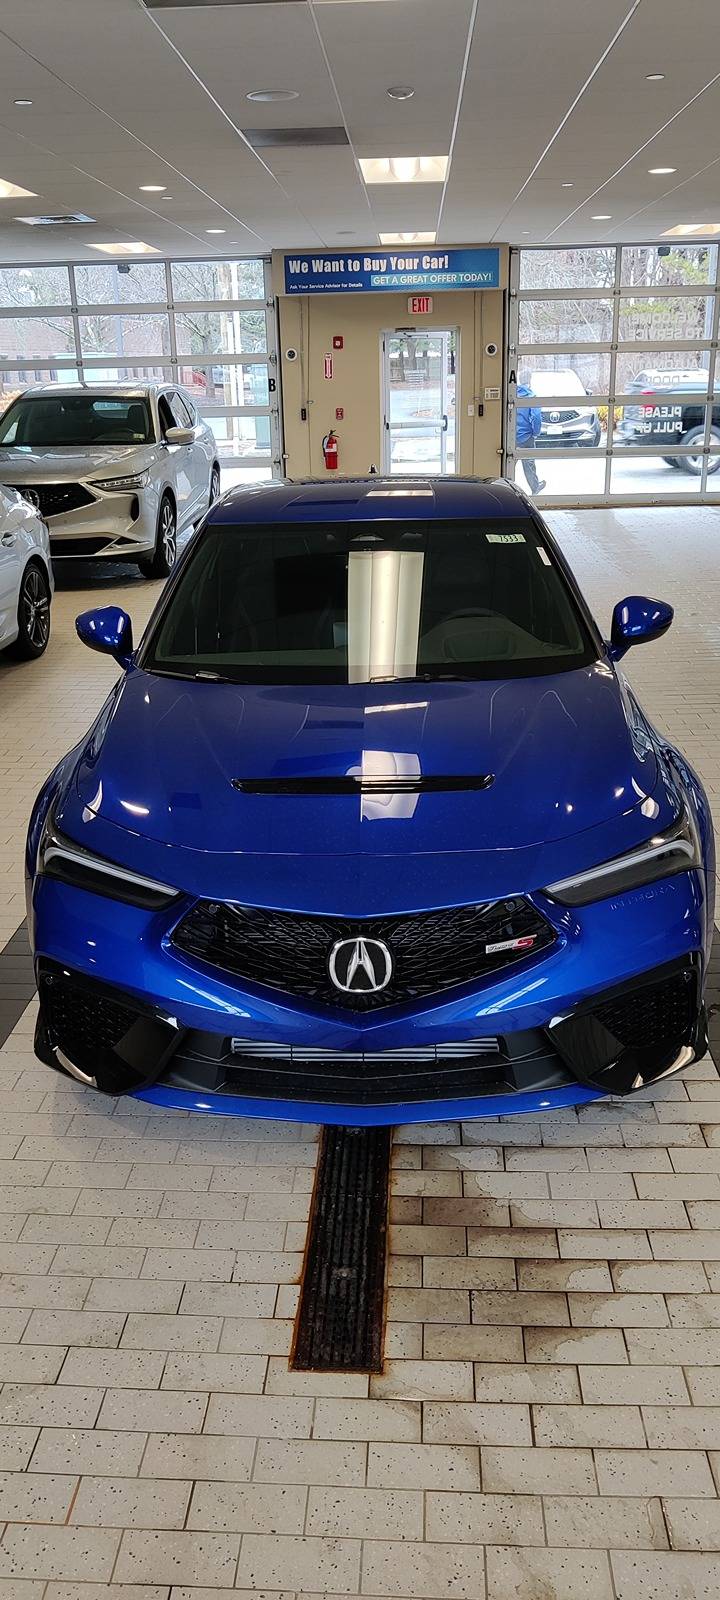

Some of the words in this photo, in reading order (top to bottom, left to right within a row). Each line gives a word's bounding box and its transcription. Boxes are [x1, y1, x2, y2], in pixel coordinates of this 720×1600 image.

[289, 260, 309, 274] We
[312, 259, 345, 273] Want
[347, 258, 360, 272] to
[363, 257, 387, 272] Buy
[389, 256, 420, 271] Your
[422, 254, 449, 269] Car!
[373, 276, 390, 285] GET
[391, 276, 399, 284] A
[400, 275, 428, 284] GREAT
[429, 274, 457, 283] OFFER
[459, 273, 492, 282] TODAY!
[412, 297, 430, 313] EXIT
[509, 370, 517, 384] A
[268, 378, 277, 392] B
